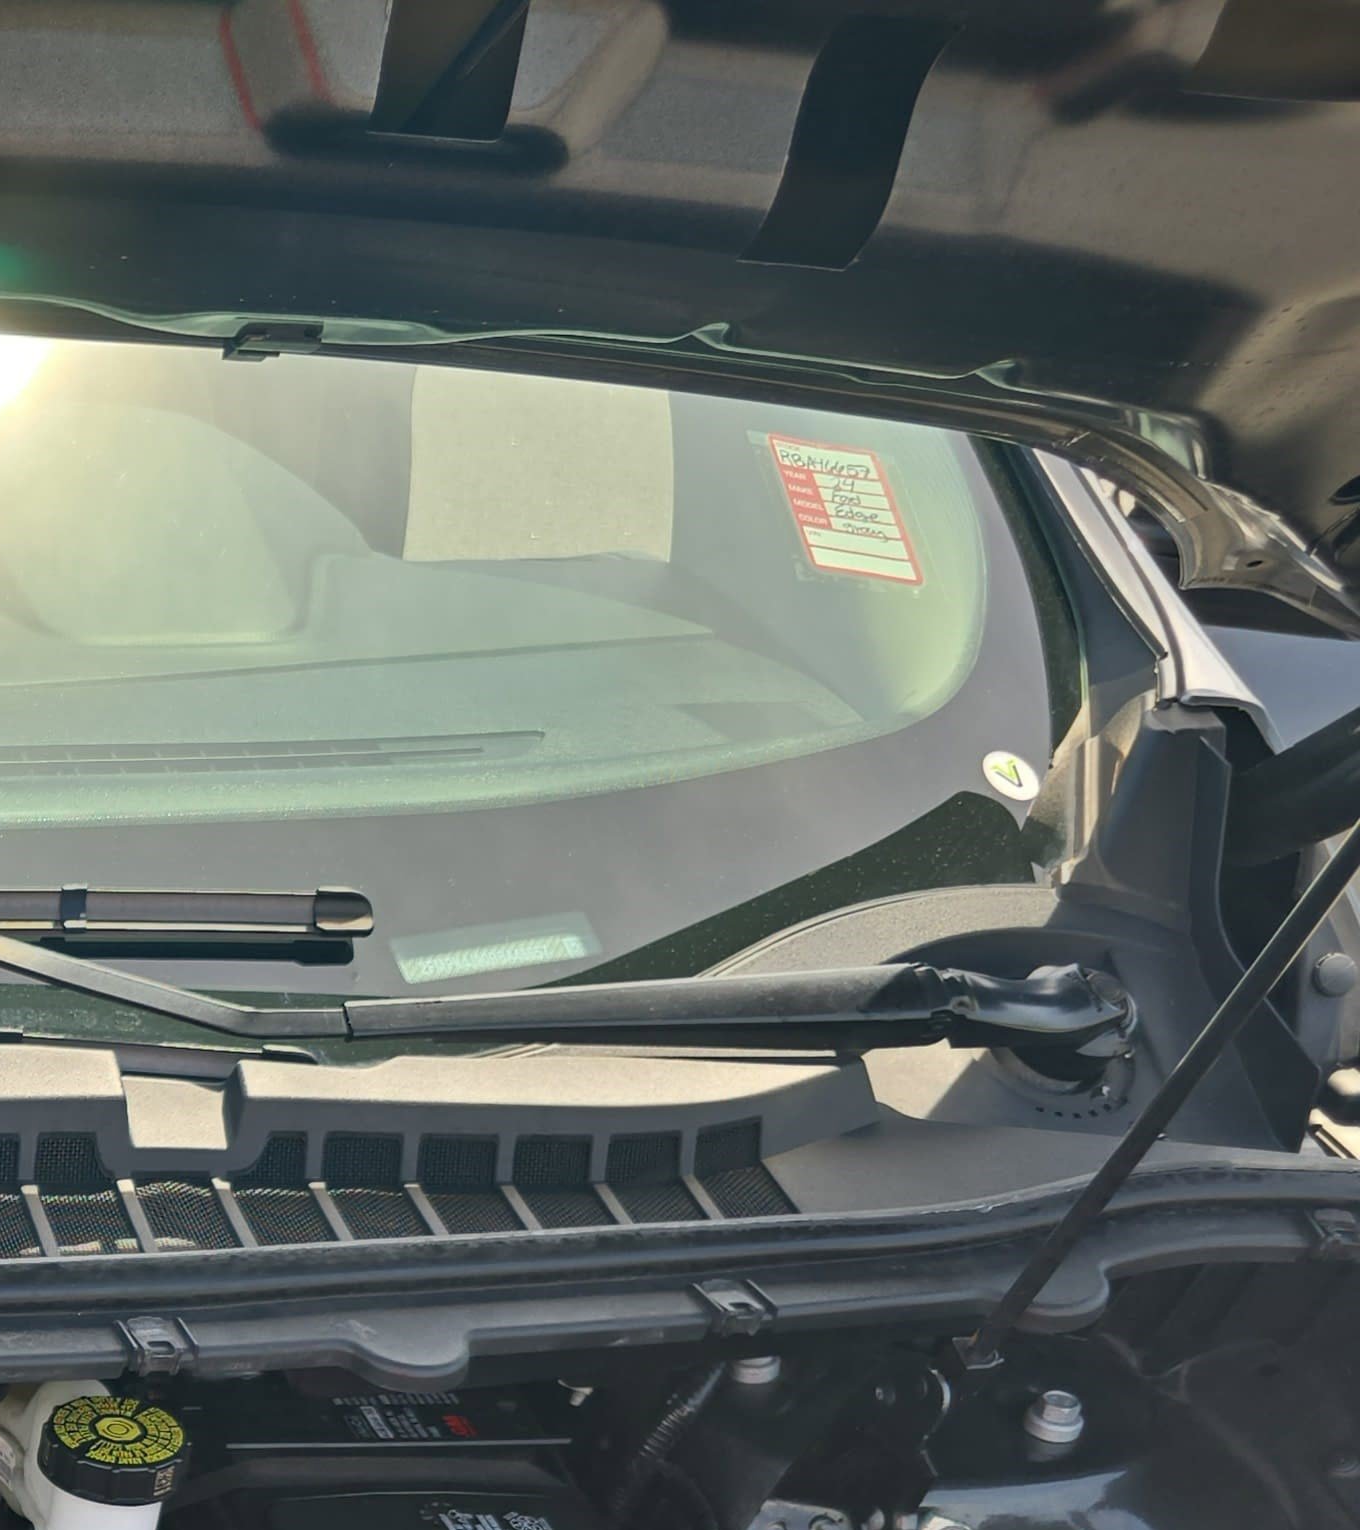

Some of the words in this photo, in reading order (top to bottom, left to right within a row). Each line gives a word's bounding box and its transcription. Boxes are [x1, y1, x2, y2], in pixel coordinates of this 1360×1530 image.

[783, 470, 807, 480] YEAR
[793, 498, 825, 511] MODEL
[797, 513, 829, 526] COLOR
